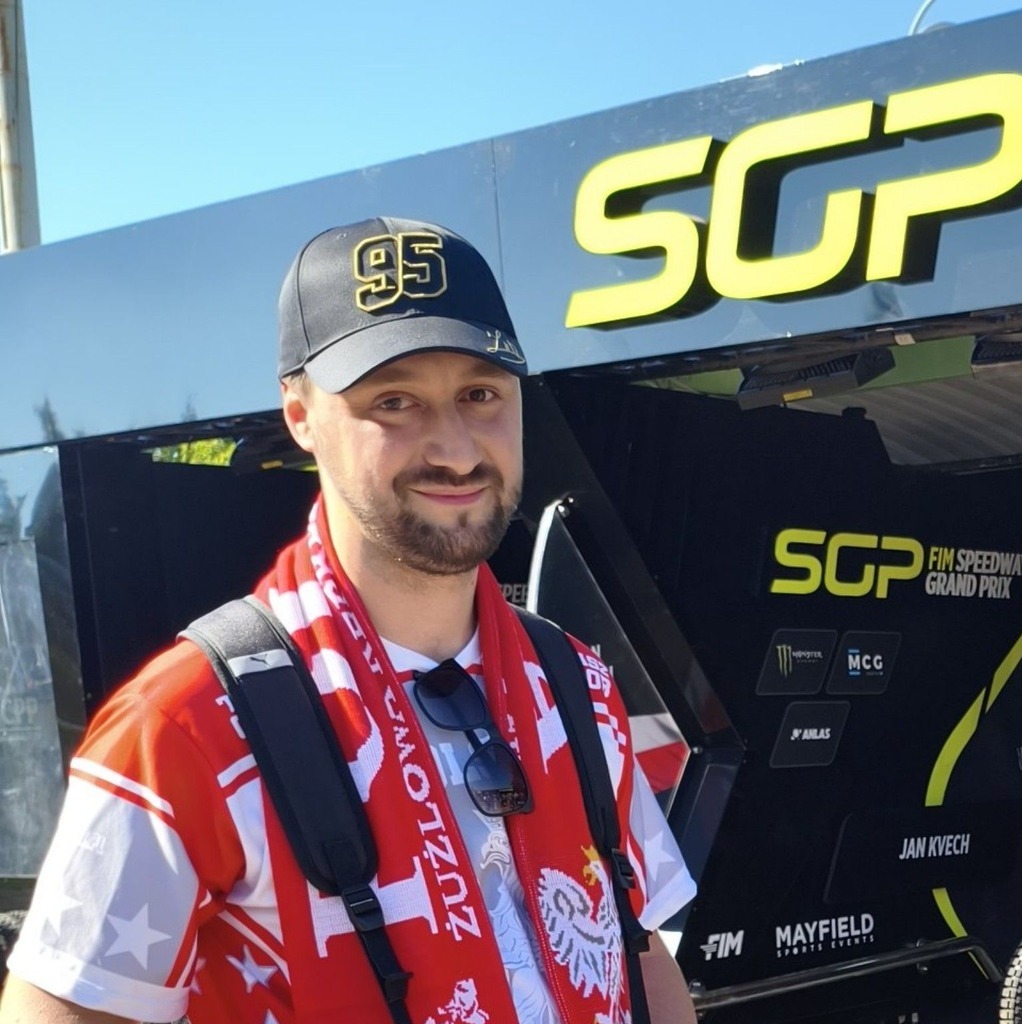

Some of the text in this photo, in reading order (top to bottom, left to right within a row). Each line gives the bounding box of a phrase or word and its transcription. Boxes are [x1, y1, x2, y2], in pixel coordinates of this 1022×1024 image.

[354, 233, 447, 312] 95
[770, 528, 924, 598] SGP
[928, 546, 953, 571] FIM
[925, 572, 1012, 599] GRAND PRIX
[848, 655, 883, 670] MCG
[899, 833, 970, 860] JAN KVECH
[700, 913, 874, 961] FIM MAYFIELD
[777, 934, 874, 958] SPORTS EVENTS
